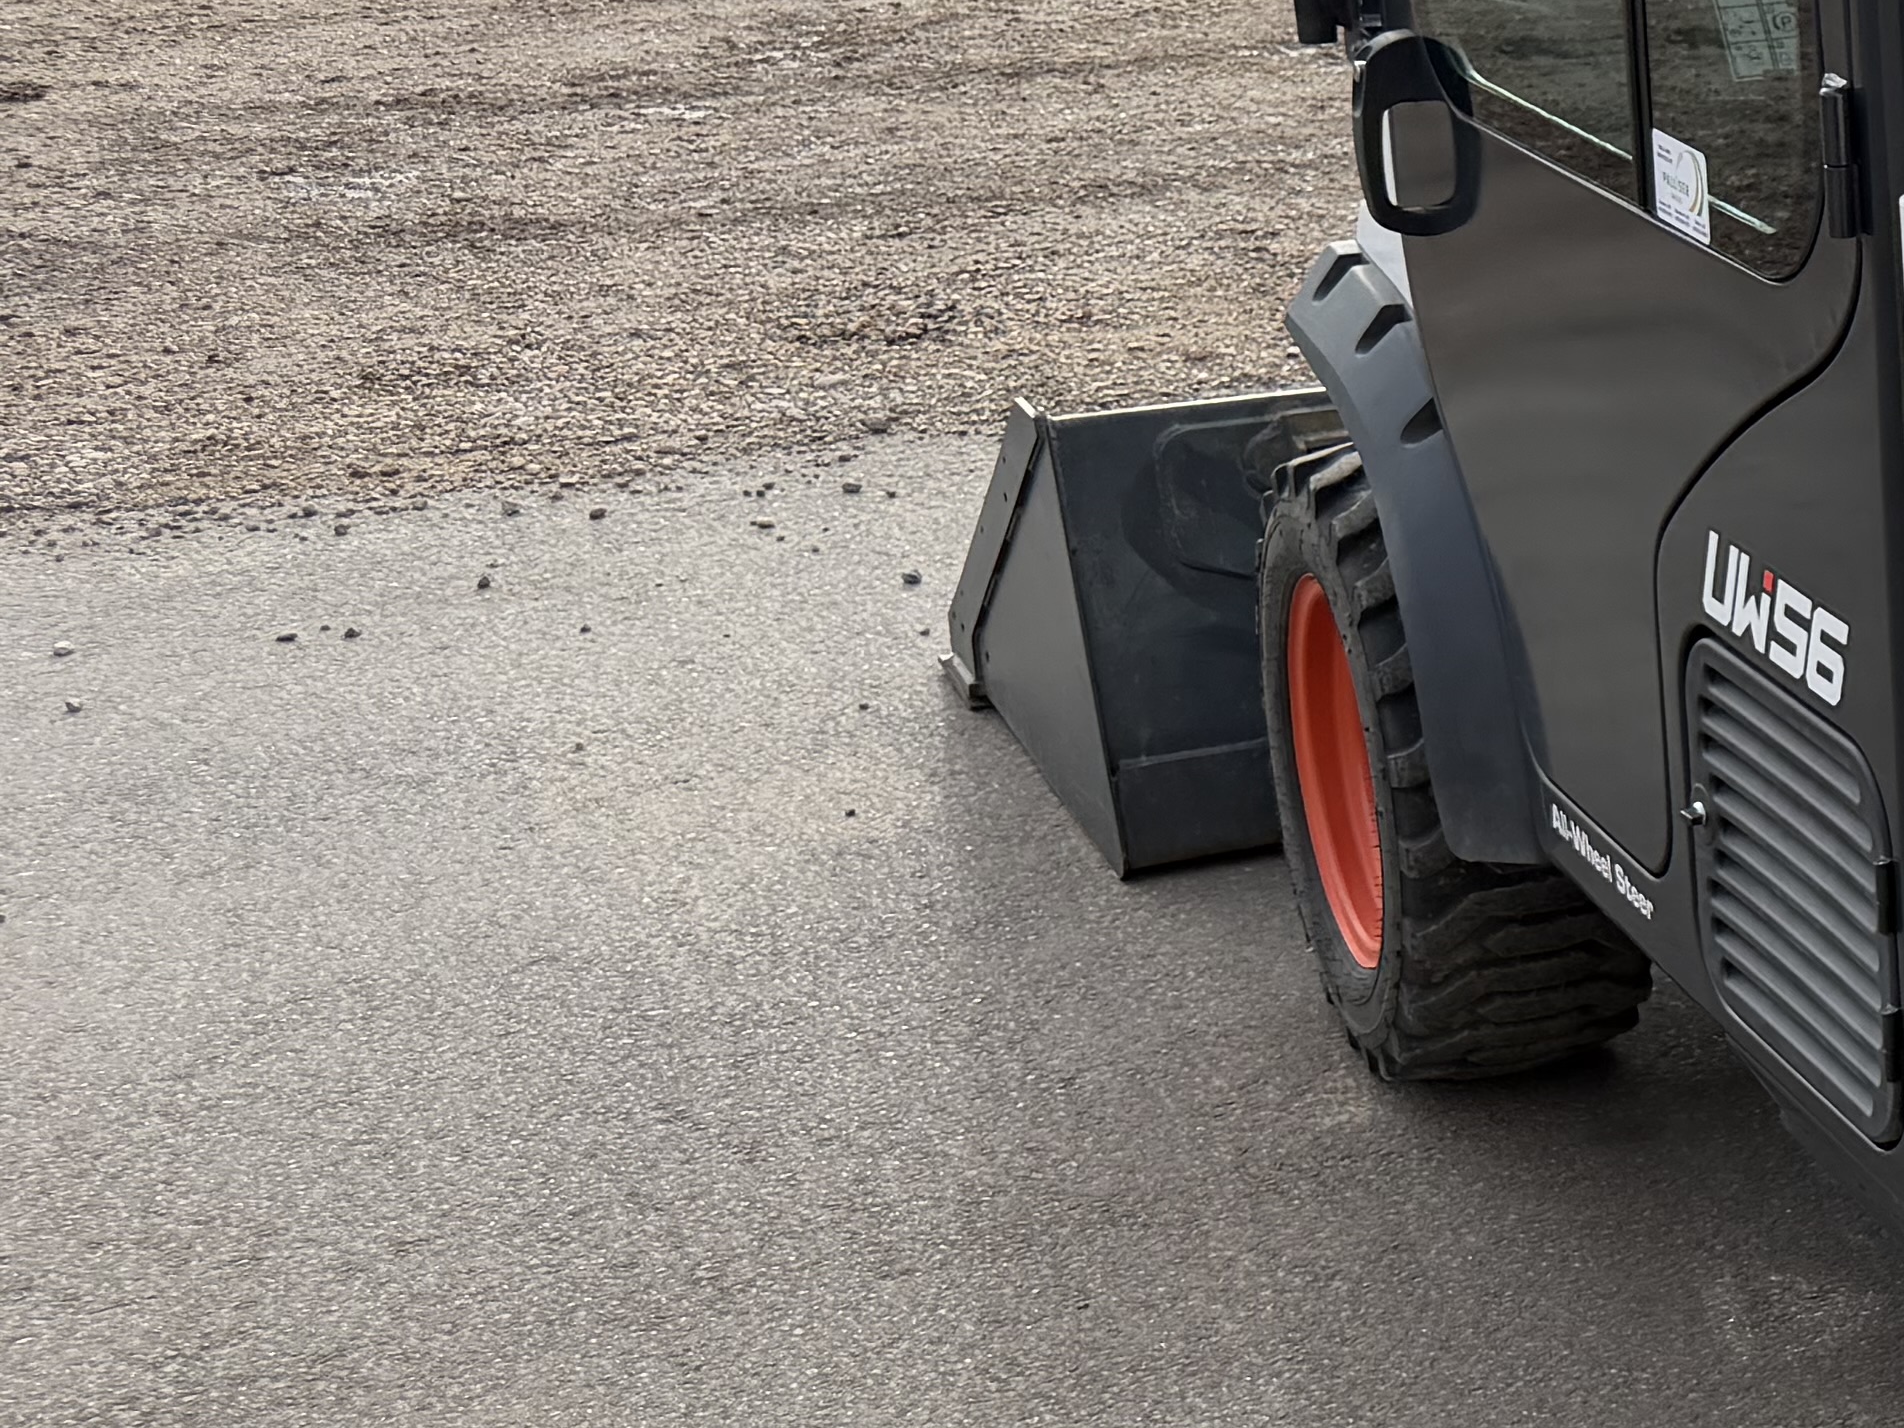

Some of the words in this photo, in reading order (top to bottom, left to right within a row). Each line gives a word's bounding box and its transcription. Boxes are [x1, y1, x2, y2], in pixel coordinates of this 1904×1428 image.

[1702, 530, 1849, 707] UW56
[1552, 803, 1613, 883] All-Wheel
[1614, 863, 1654, 920] Steer
